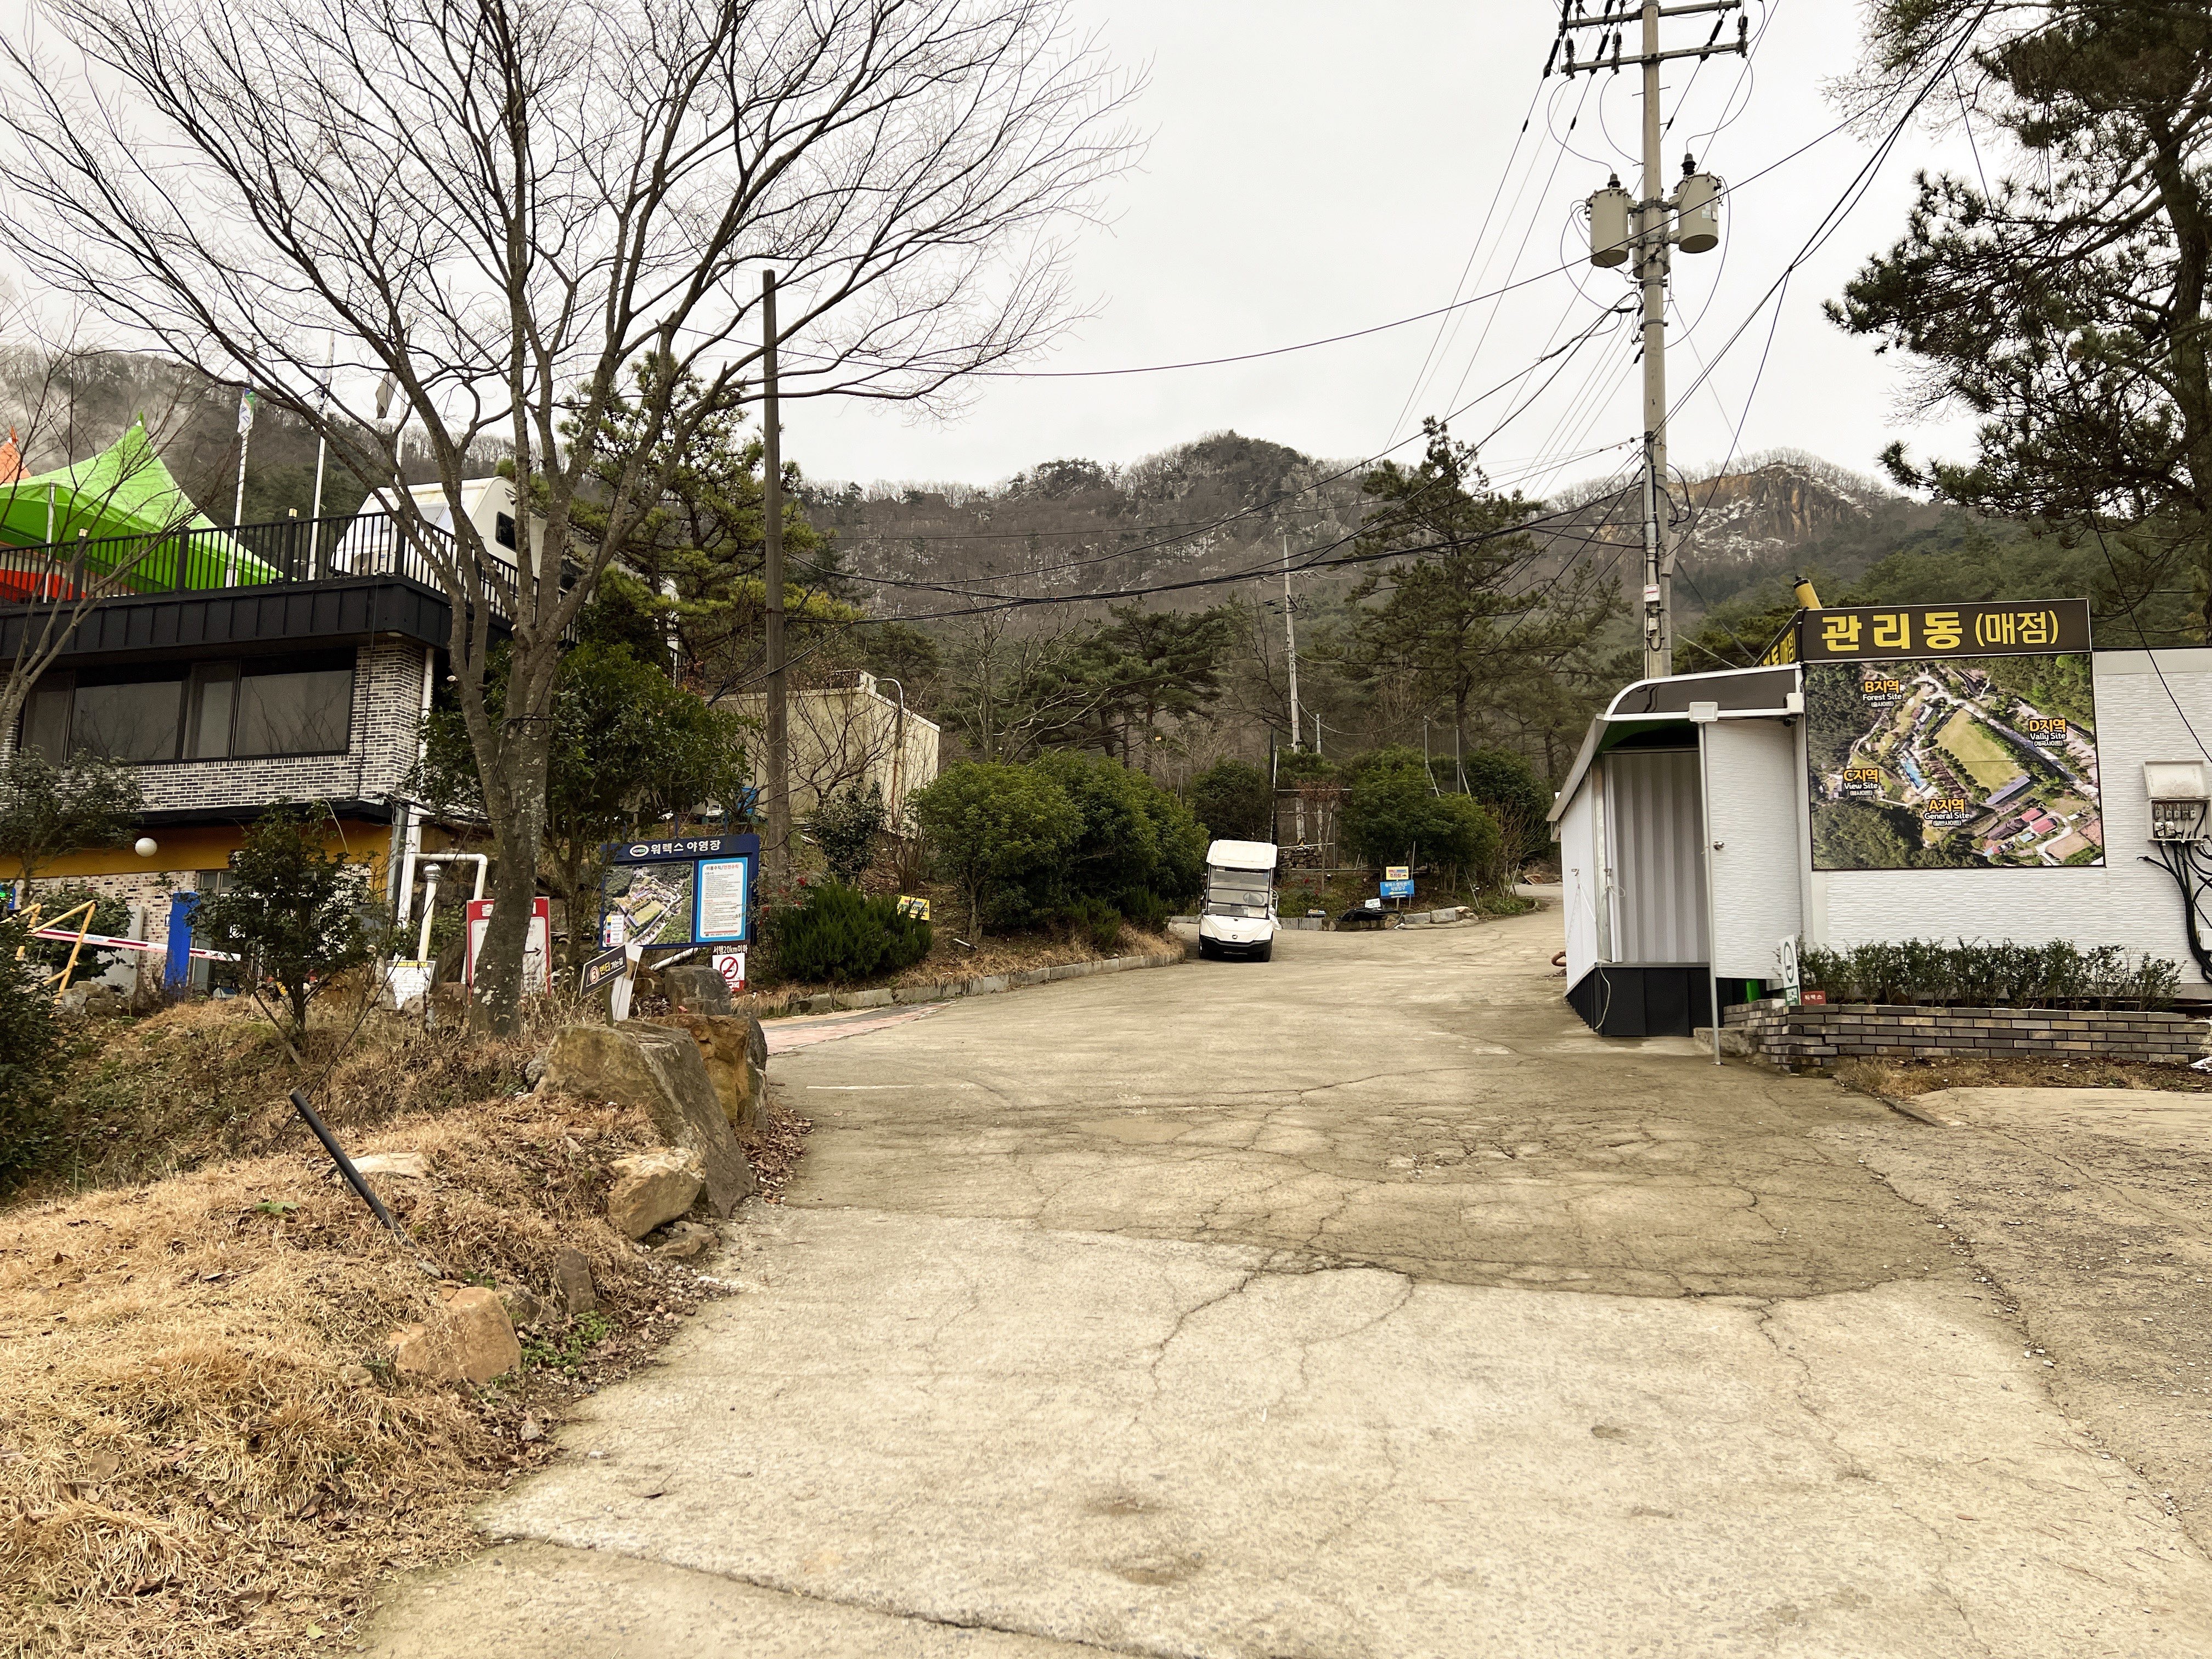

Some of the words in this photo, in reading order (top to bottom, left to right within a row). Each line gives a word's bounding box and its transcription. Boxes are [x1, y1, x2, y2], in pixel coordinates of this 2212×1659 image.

[1821, 612, 1962, 651] 관리동
[1976, 610, 2058, 647] (매점)
[1865, 680, 1899, 693] B지역
[2029, 719, 2066, 732] D지역
[2030, 732, 2049, 741] Vally
[1843, 769, 1878, 782] C지역
[1929, 799, 1965, 812] A지역
[651, 843, 684, 855] 워렉스
[687, 840, 721, 852] 야영장
[713, 944, 748, 955] 서행20km이하
